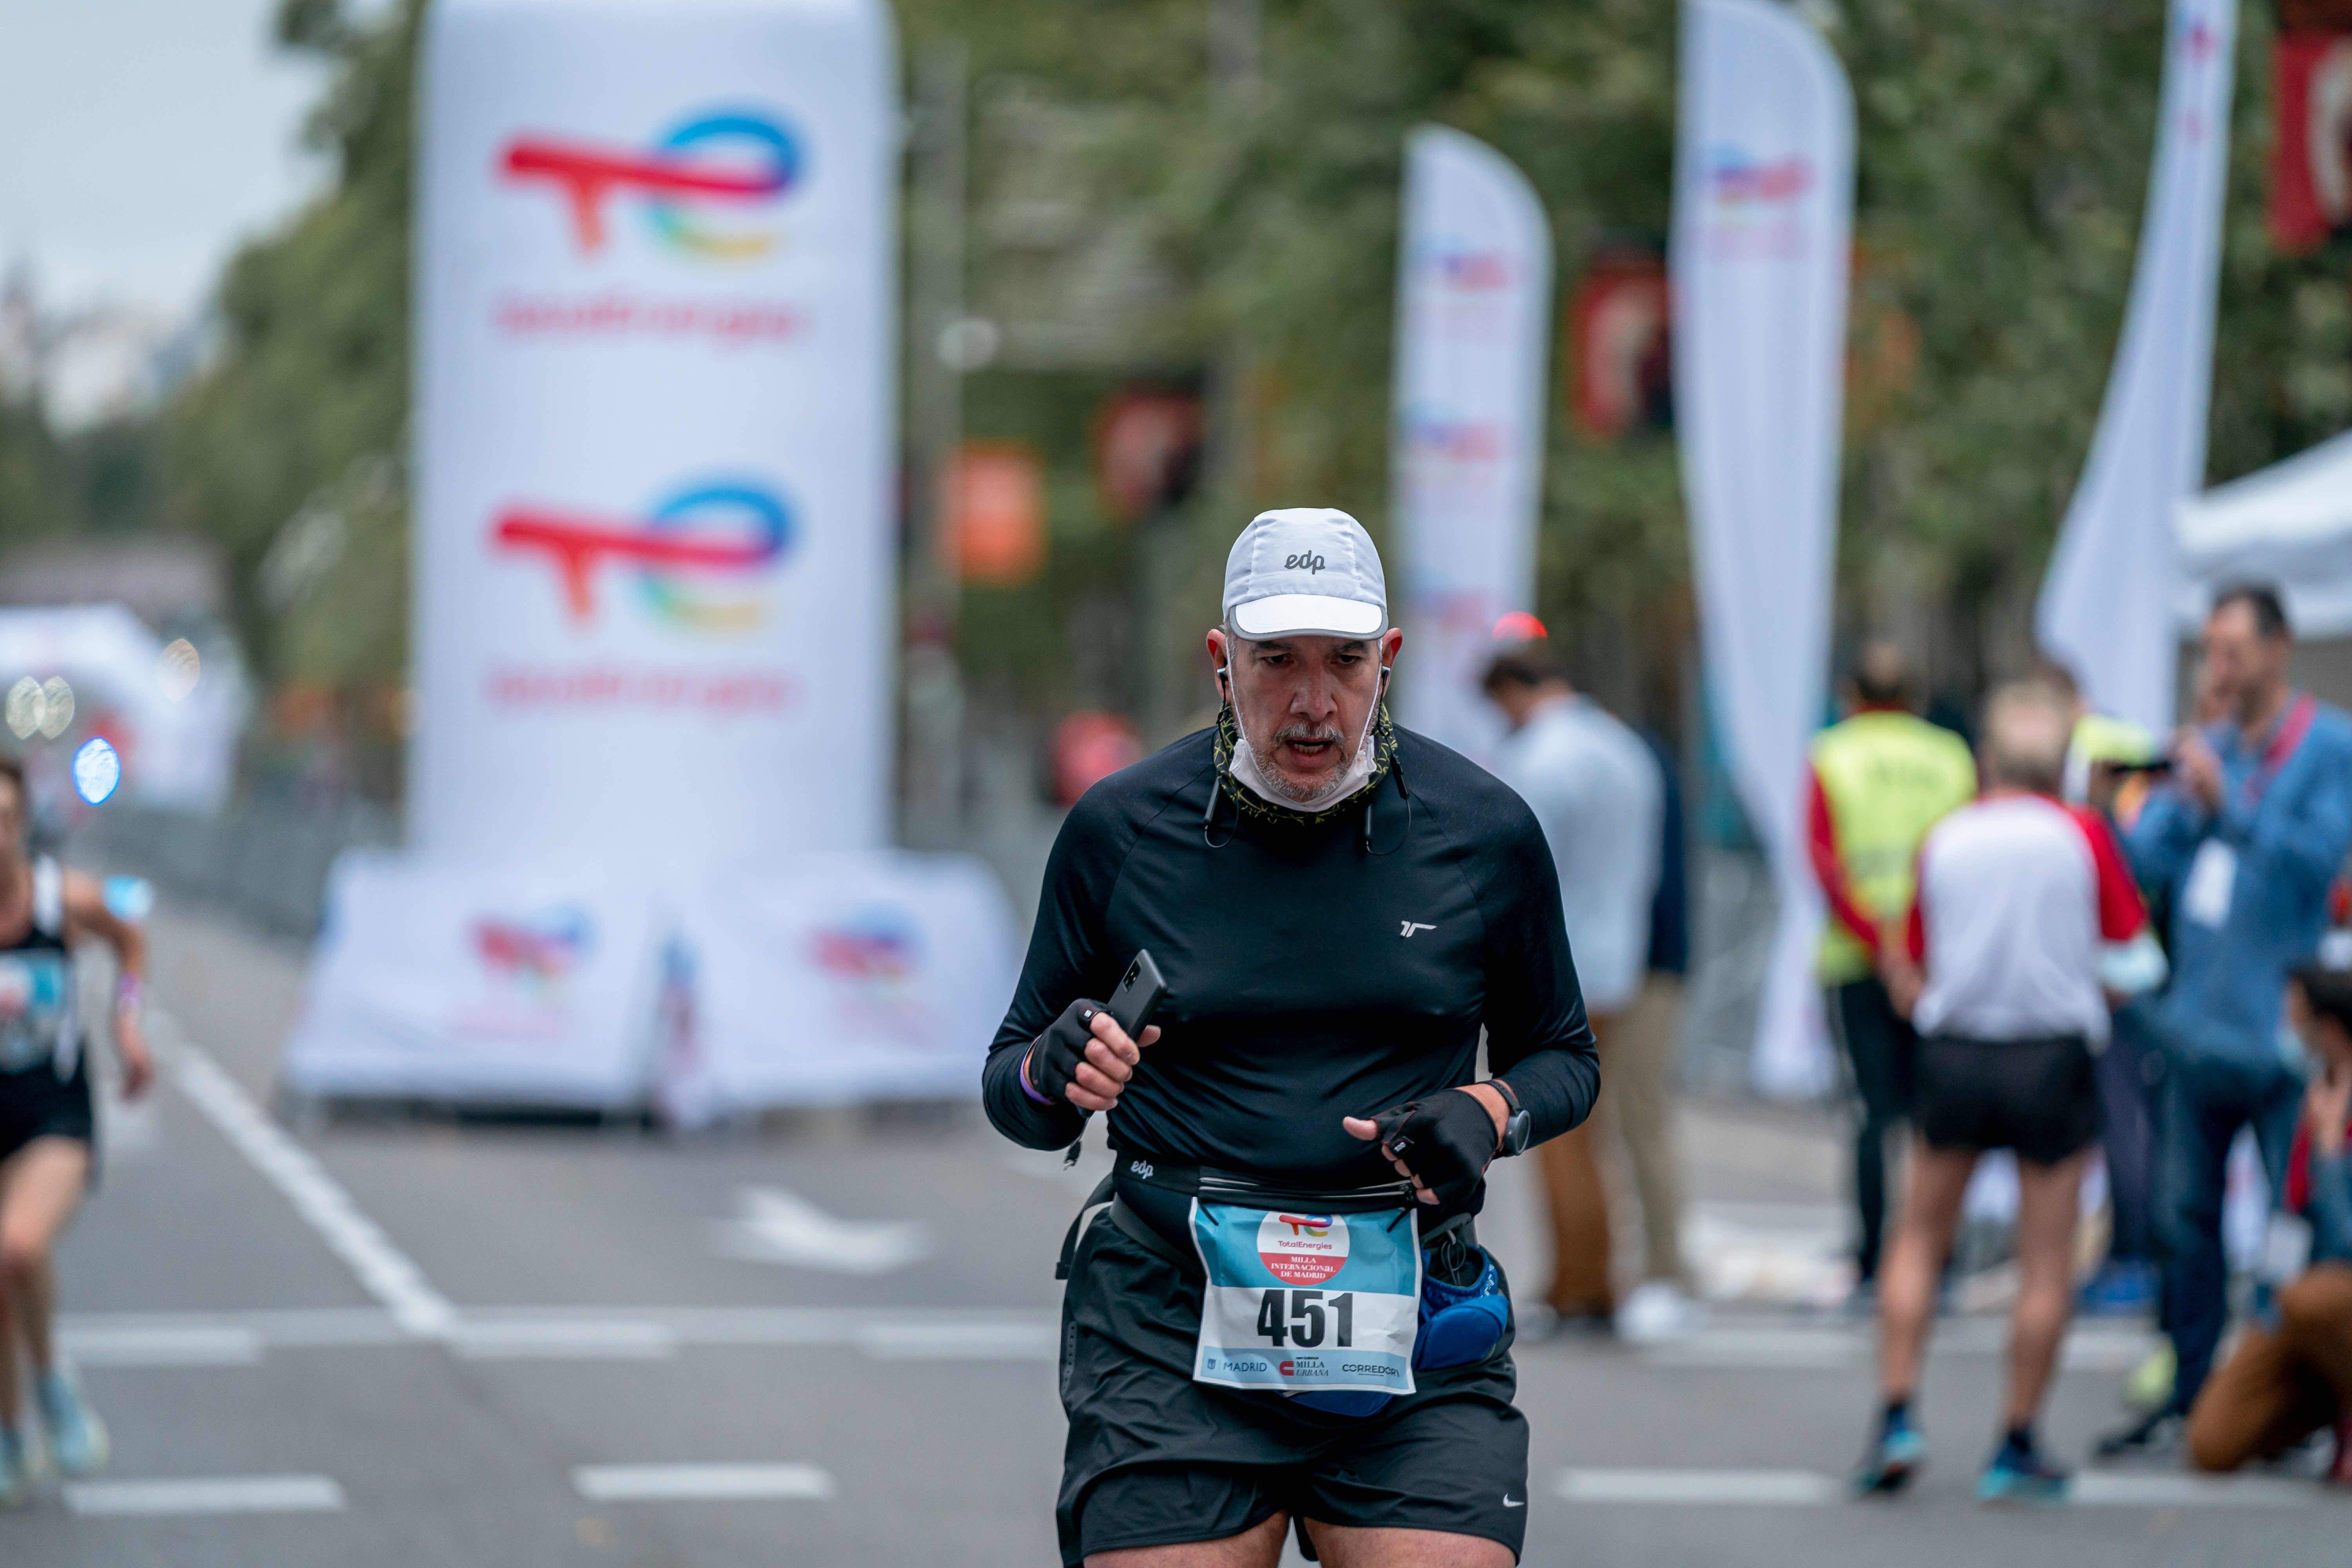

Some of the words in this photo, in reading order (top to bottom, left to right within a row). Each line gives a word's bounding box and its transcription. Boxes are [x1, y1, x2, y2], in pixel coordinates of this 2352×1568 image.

[1284, 550, 1326, 575] edp
[1130, 1160, 1154, 1180] edp
[1278, 1240, 1333, 1250] TotalEnergies
[1257, 1289, 1354, 1348] 451
[1223, 1362, 1267, 1372] MADRID
